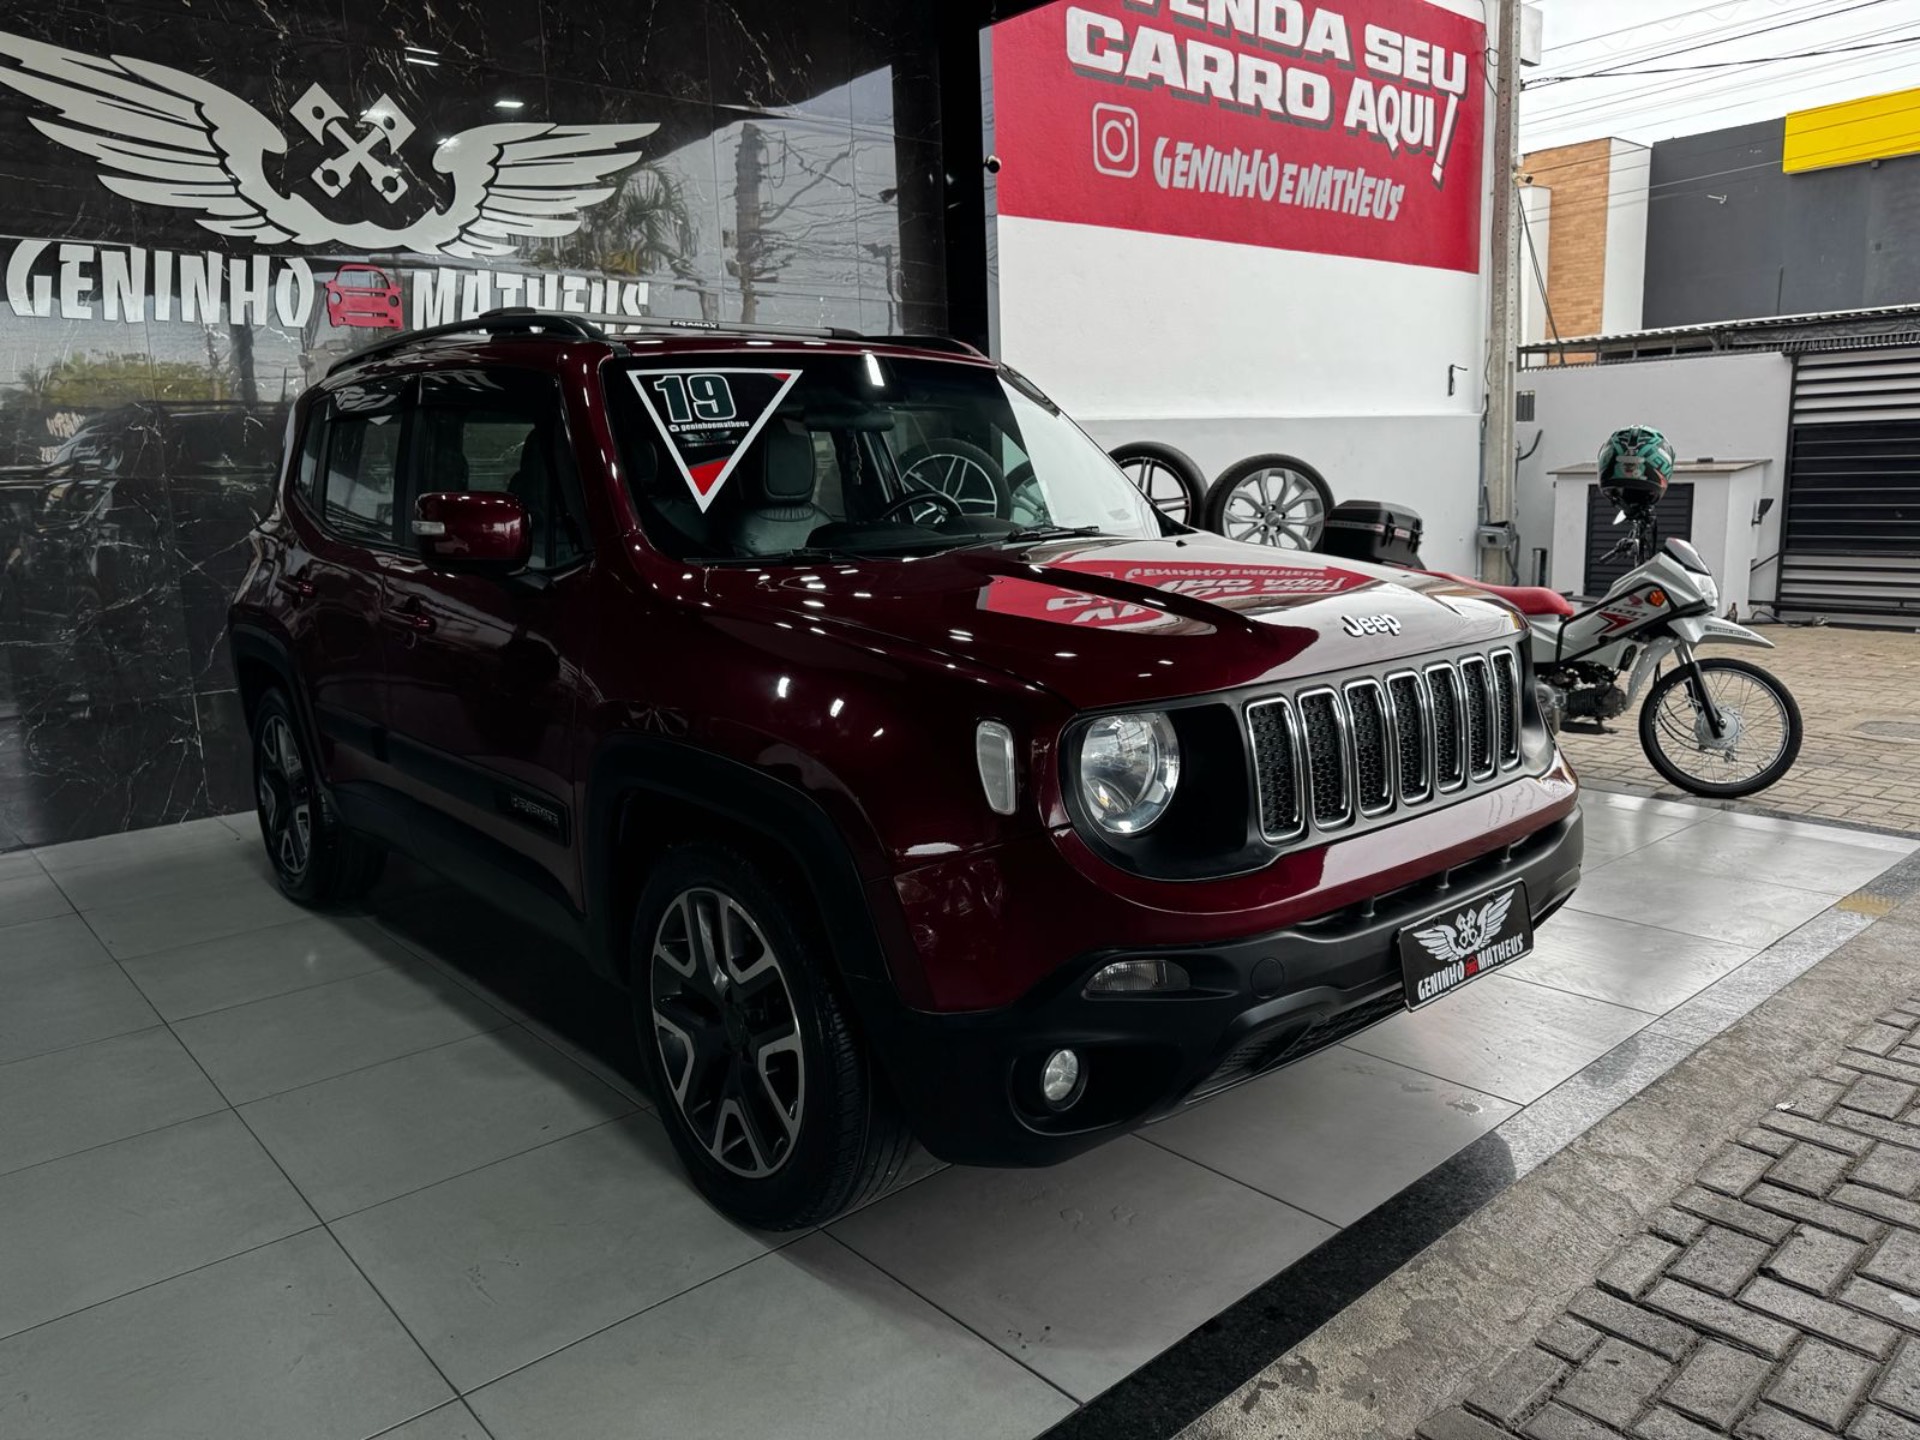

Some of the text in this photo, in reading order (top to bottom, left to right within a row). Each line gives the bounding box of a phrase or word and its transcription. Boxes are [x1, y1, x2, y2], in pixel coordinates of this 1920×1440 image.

[1065, 6, 1331, 122] CARRO
[1128, 0, 1467, 95] NDA SEU
[6, 239, 649, 335] GENINHO MATHEUS
[653, 374, 738, 423] 19
[1341, 614, 1402, 638] Jeep
[1416, 933, 1524, 1001] GENINHO MATHEUS
